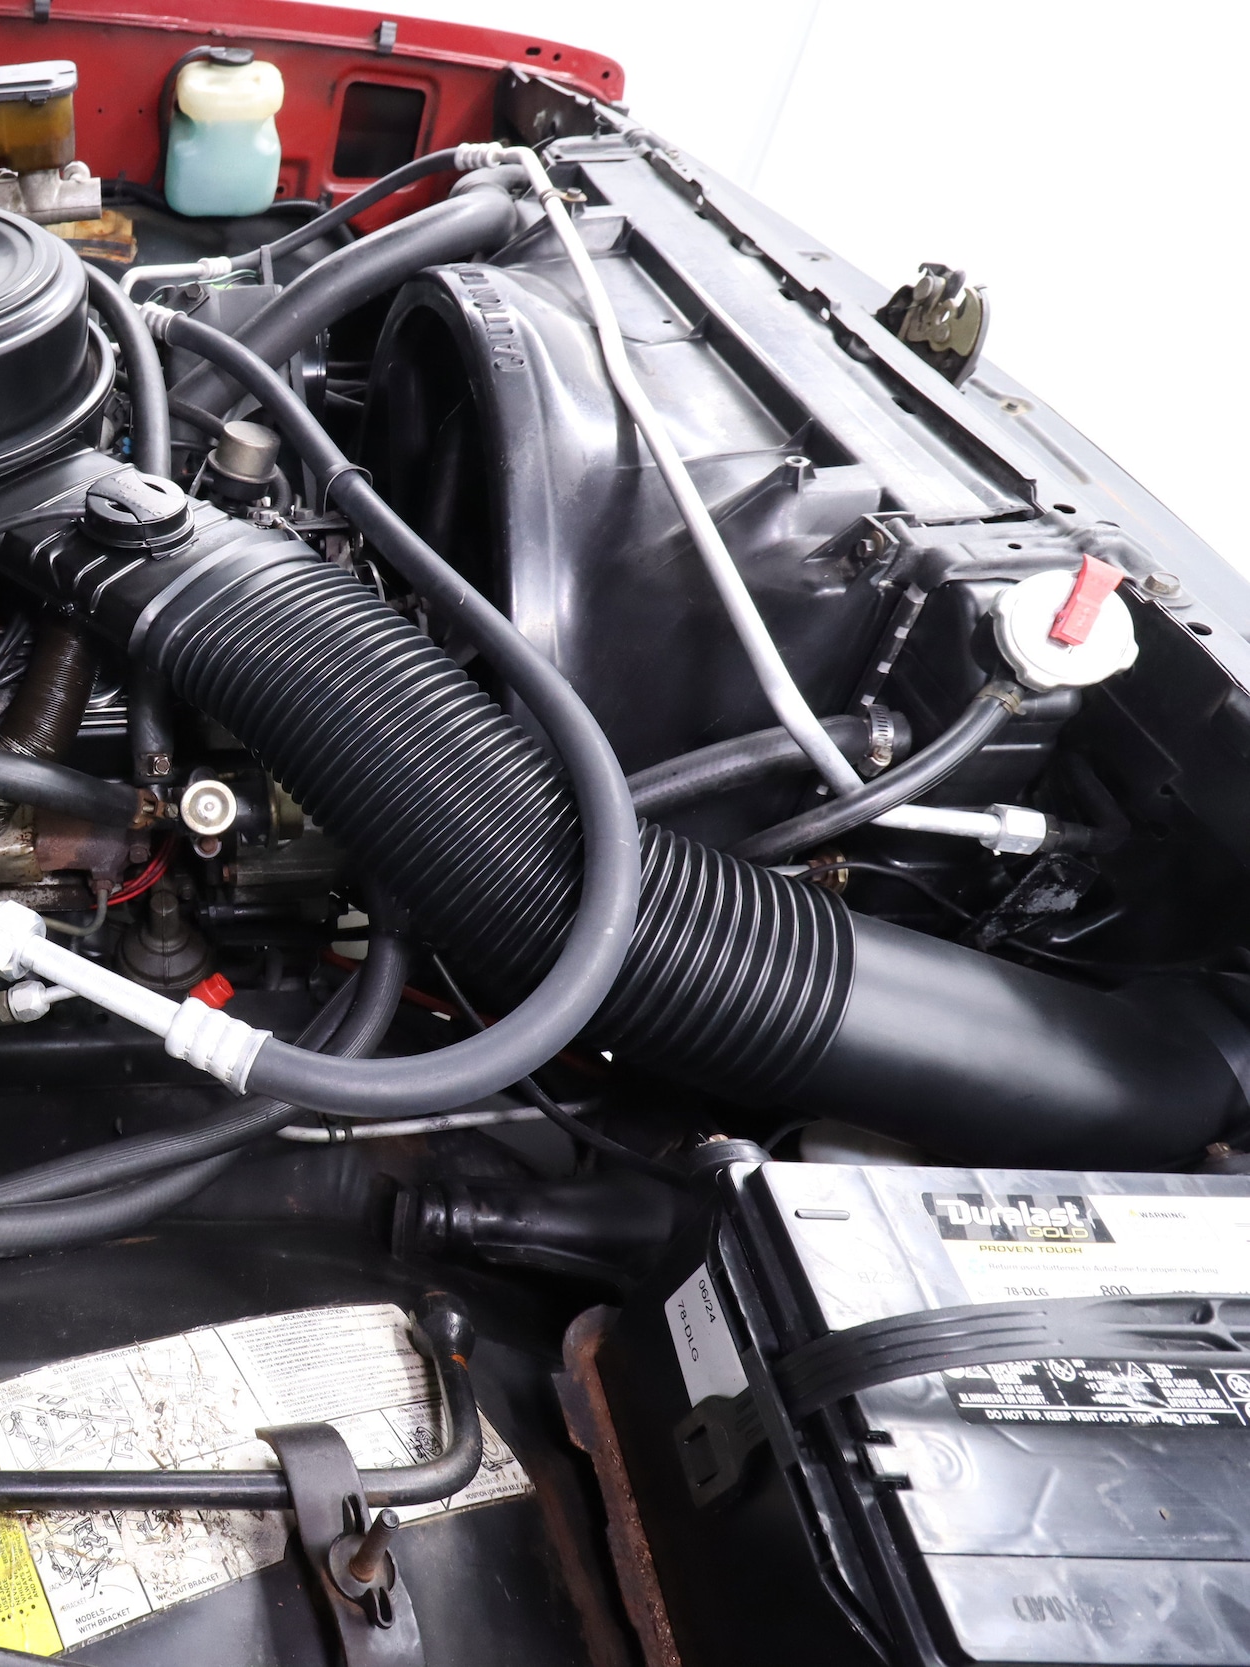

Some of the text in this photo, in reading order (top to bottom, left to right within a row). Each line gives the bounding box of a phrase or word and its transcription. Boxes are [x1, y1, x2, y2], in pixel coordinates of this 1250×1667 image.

[936, 1200, 1084, 1227] Duralast
[1026, 1227, 1089, 1238] GOLD
[980, 1245, 1082, 1254] PROVEN TOUGH
[1005, 1287, 1049, 1297] 78-DLG
[1100, 1285, 1132, 1297] 800
[699, 1279, 717, 1323] 06/24
[281, 1313, 305, 1322] JACKING
[305, 1309, 349, 1320] INSTRUCTIONS
[677, 1300, 699, 1362] 78-DLG
[93, 1343, 150, 1363] INSTRUCTIONS
[998, 1384, 1043, 1395] CAN CAUSE
[1157, 1378, 1201, 1389] CAN CAUSE
[985, 1410, 1002, 1420] DO
[1003, 1410, 1025, 1421] NOT
[1027, 1410, 1045, 1421] TIP.
[1045, 1411, 1072, 1422] KEEP
[1072, 1411, 1100, 1423] VENT
[1100, 1412, 1129, 1423] CAPS
[1183, 1414, 1220, 1425] LEVEL.
[187, 1572, 219, 1589] BRACKET
[29, 1582, 38, 1598] AND
[77, 1606, 132, 1634] WITH BRACKET
